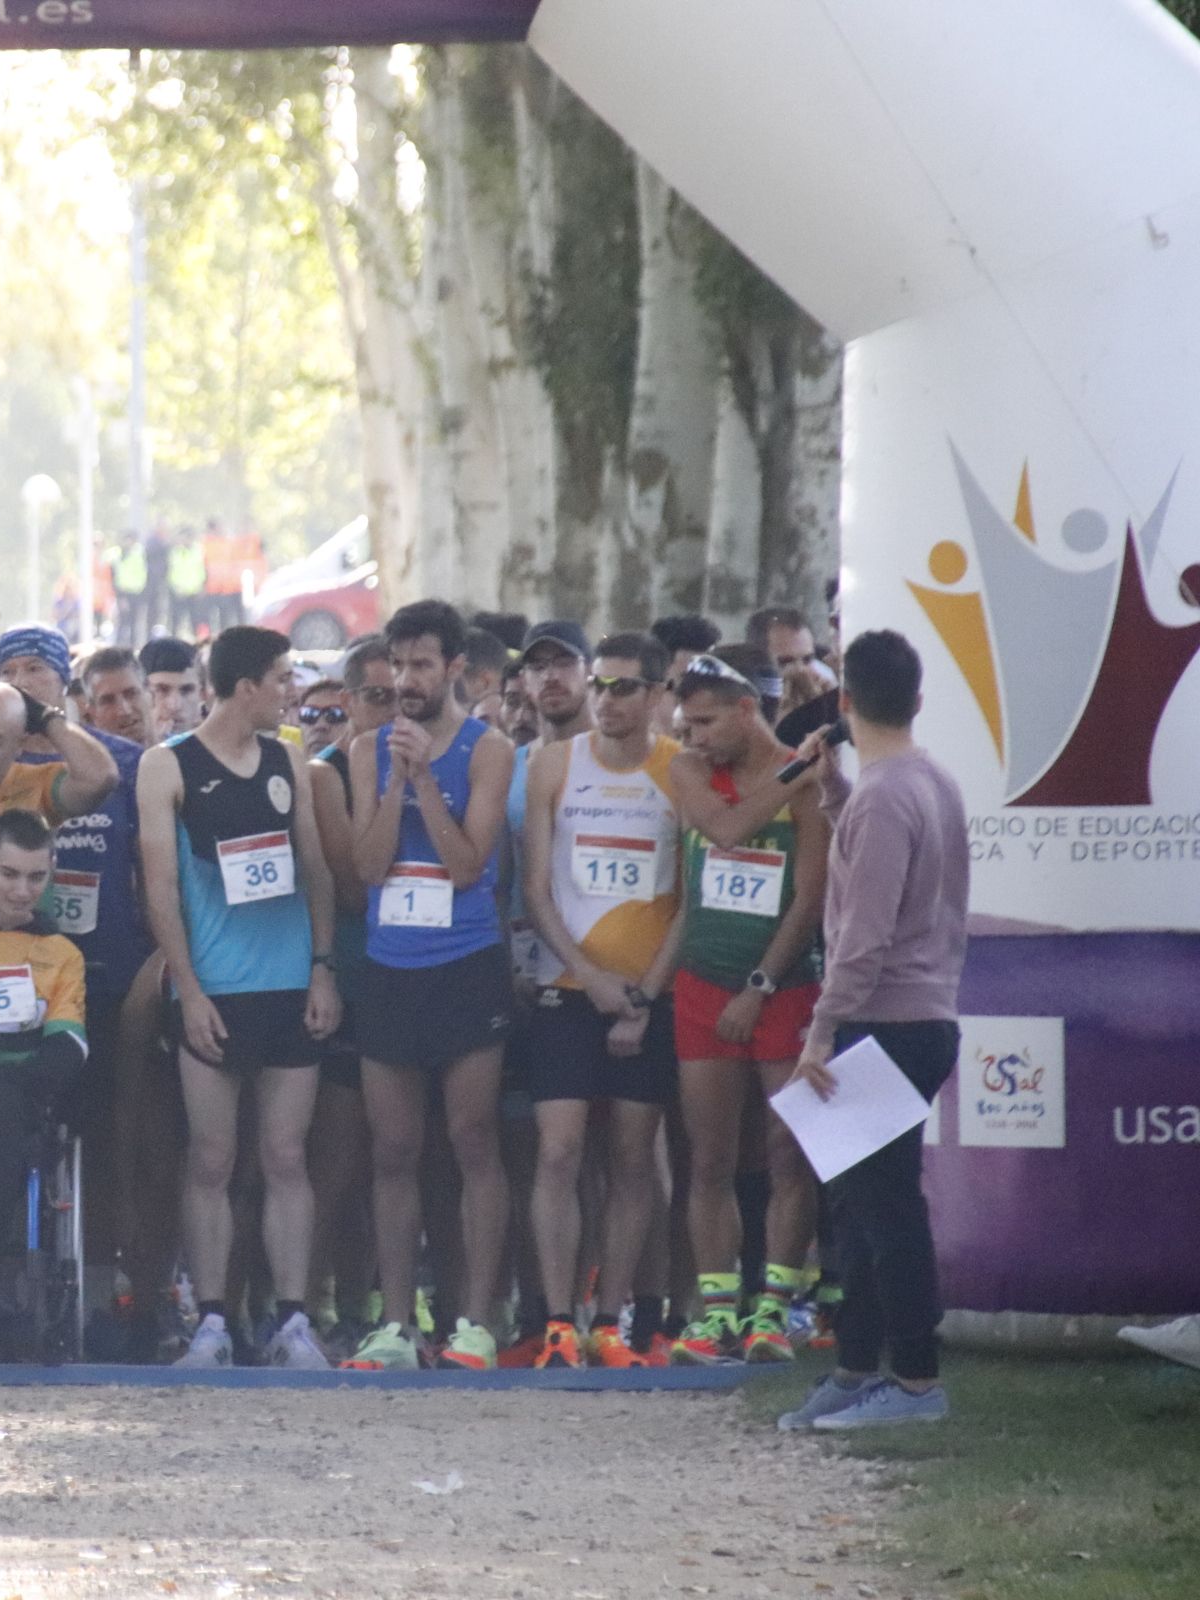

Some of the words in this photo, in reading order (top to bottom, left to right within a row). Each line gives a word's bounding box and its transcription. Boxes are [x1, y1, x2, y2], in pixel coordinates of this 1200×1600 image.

[1035, 816, 1068, 837] DE
[1027, 840, 1045, 861] Y
[245, 861, 278, 886] 36
[587, 859, 640, 887] 113
[715, 873, 767, 899] 187
[404, 889, 415, 912] 1
[1113, 1103, 1200, 1145] usa
